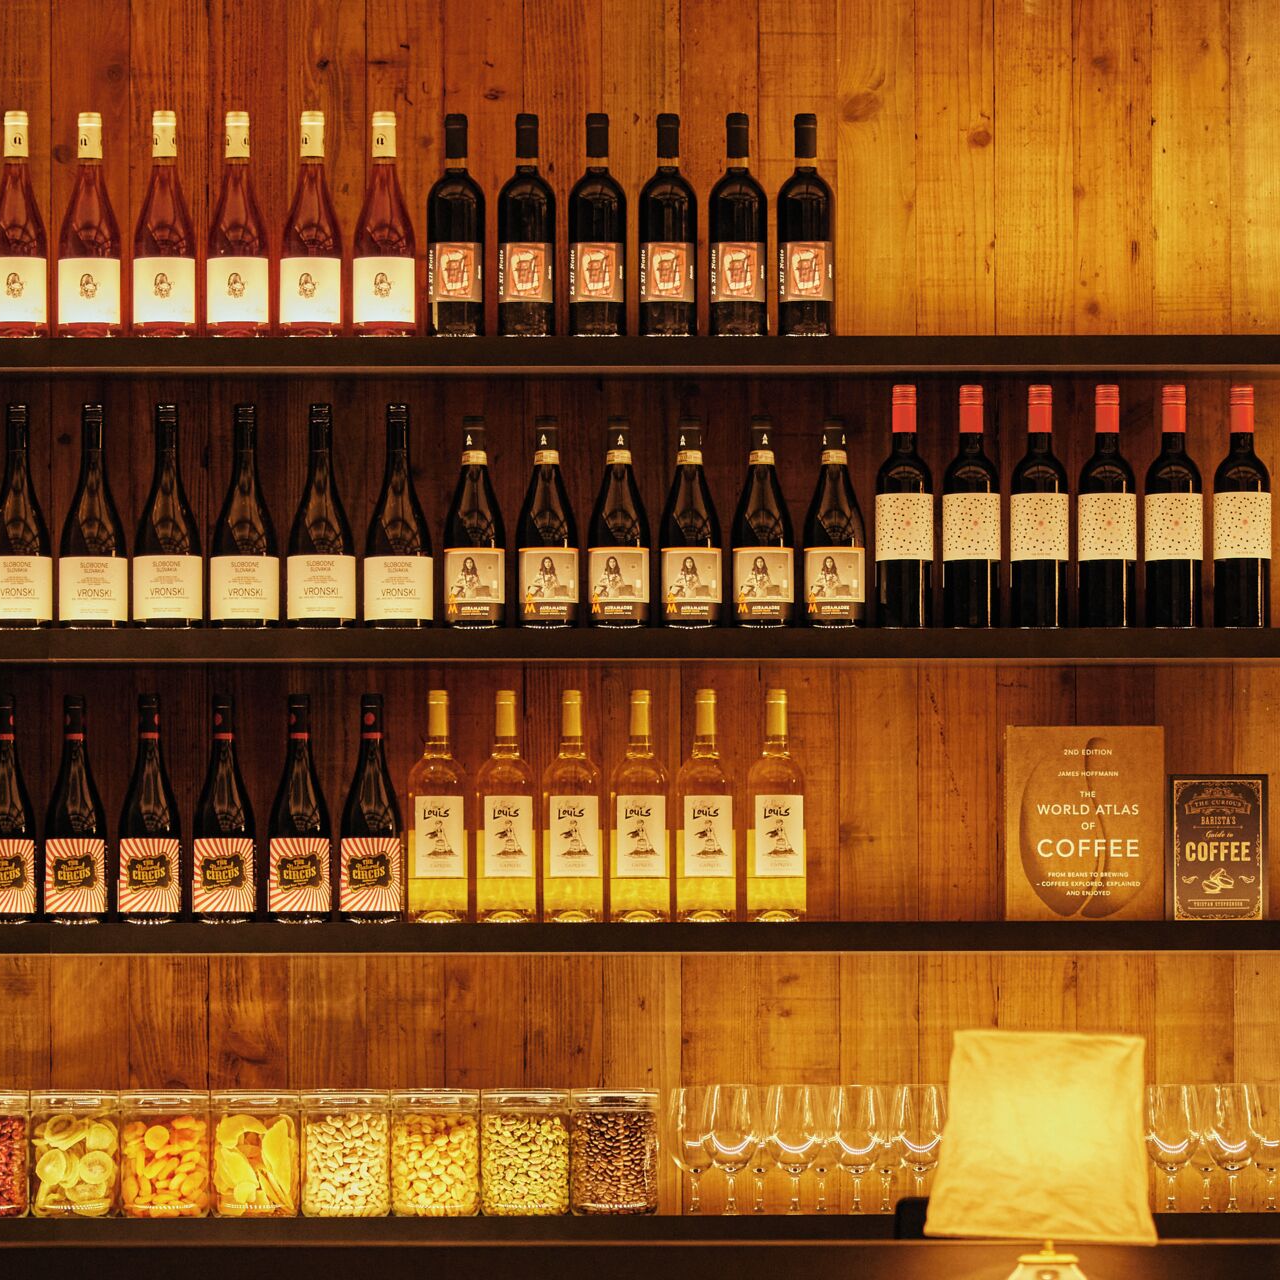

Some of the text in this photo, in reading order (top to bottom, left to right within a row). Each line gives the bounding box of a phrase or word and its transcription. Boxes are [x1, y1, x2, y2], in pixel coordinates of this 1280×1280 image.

[0, 588, 36, 596] VRONSKI
[77, 589, 112, 598] VRONSKI
[150, 588, 185, 596] VRONSKI
[228, 588, 263, 596] VRONSKI
[303, 587, 339, 596] VRONSKI
[381, 588, 416, 597] VRONSKI
[423, 807, 450, 820] Louis
[493, 807, 520, 820] Louis
[558, 807, 585, 820] Louis
[625, 807, 652, 819] Louis
[693, 807, 719, 819] Louis
[764, 807, 791, 819] Louis
[1037, 804, 1139, 815] WORLD ATLAS
[1081, 822, 1096, 830] OF
[1201, 816, 1236, 825] BARISTA'S
[1205, 830, 1225, 839] Guide
[1037, 838, 1140, 858] COFFEE
[1185, 842, 1251, 862] COFFEE
[58, 869, 91, 880] CIRCUS
[132, 869, 166, 880] CIRCUS
[206, 869, 240, 880] CIRCUS
[283, 869, 316, 880] CIRCUS
[352, 869, 385, 880] CIRCUS
